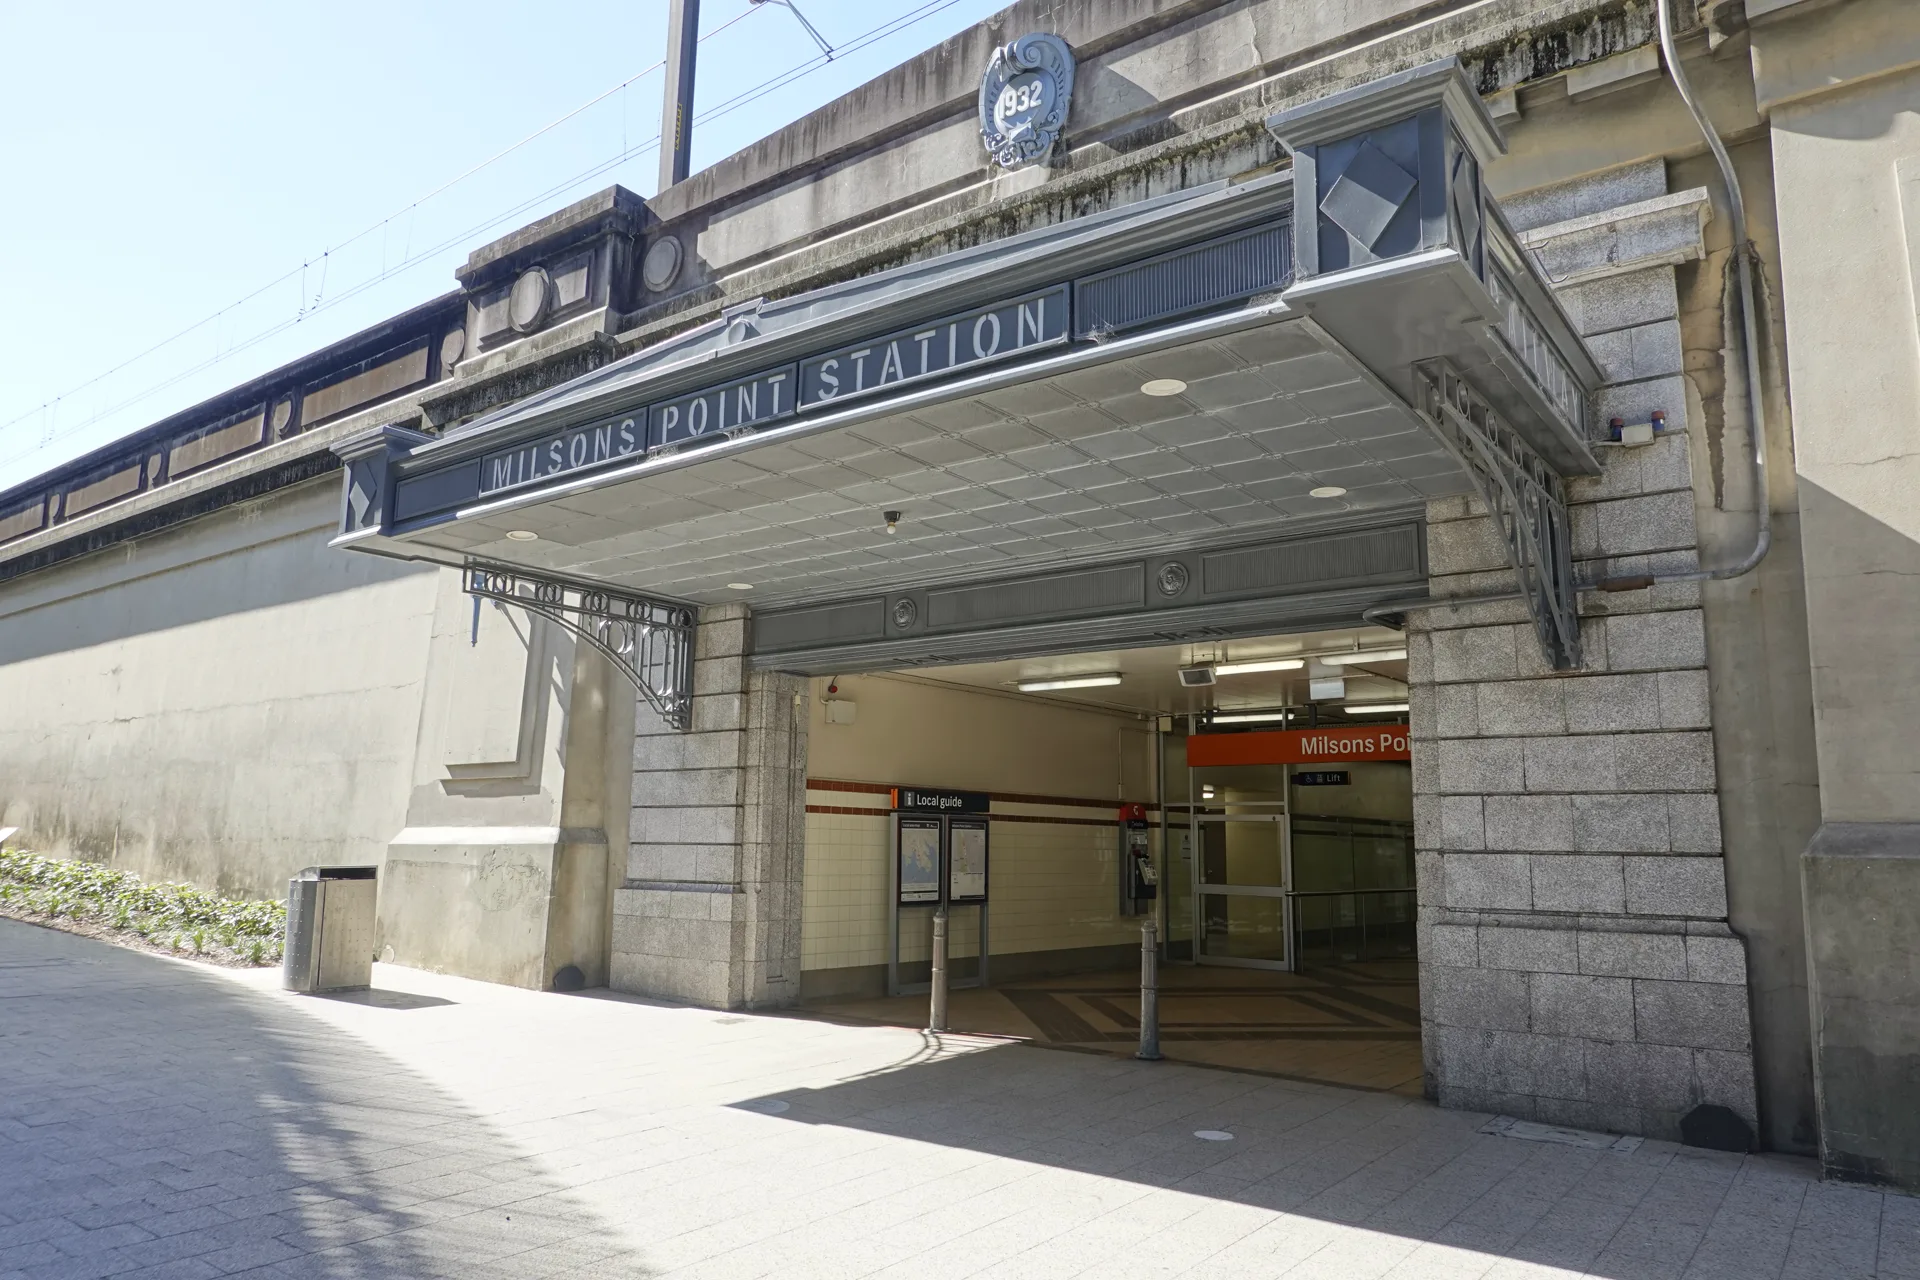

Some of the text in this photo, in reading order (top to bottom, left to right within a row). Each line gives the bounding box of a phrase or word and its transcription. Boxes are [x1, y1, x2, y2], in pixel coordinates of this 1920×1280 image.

[999, 80, 1042, 121] 1932
[492, 298, 1045, 490] MILSONS POINT STATION
[1301, 735, 1375, 755] Milsons
[1326, 773, 1341, 782] Lift
[917, 793, 962, 809] Local guide
